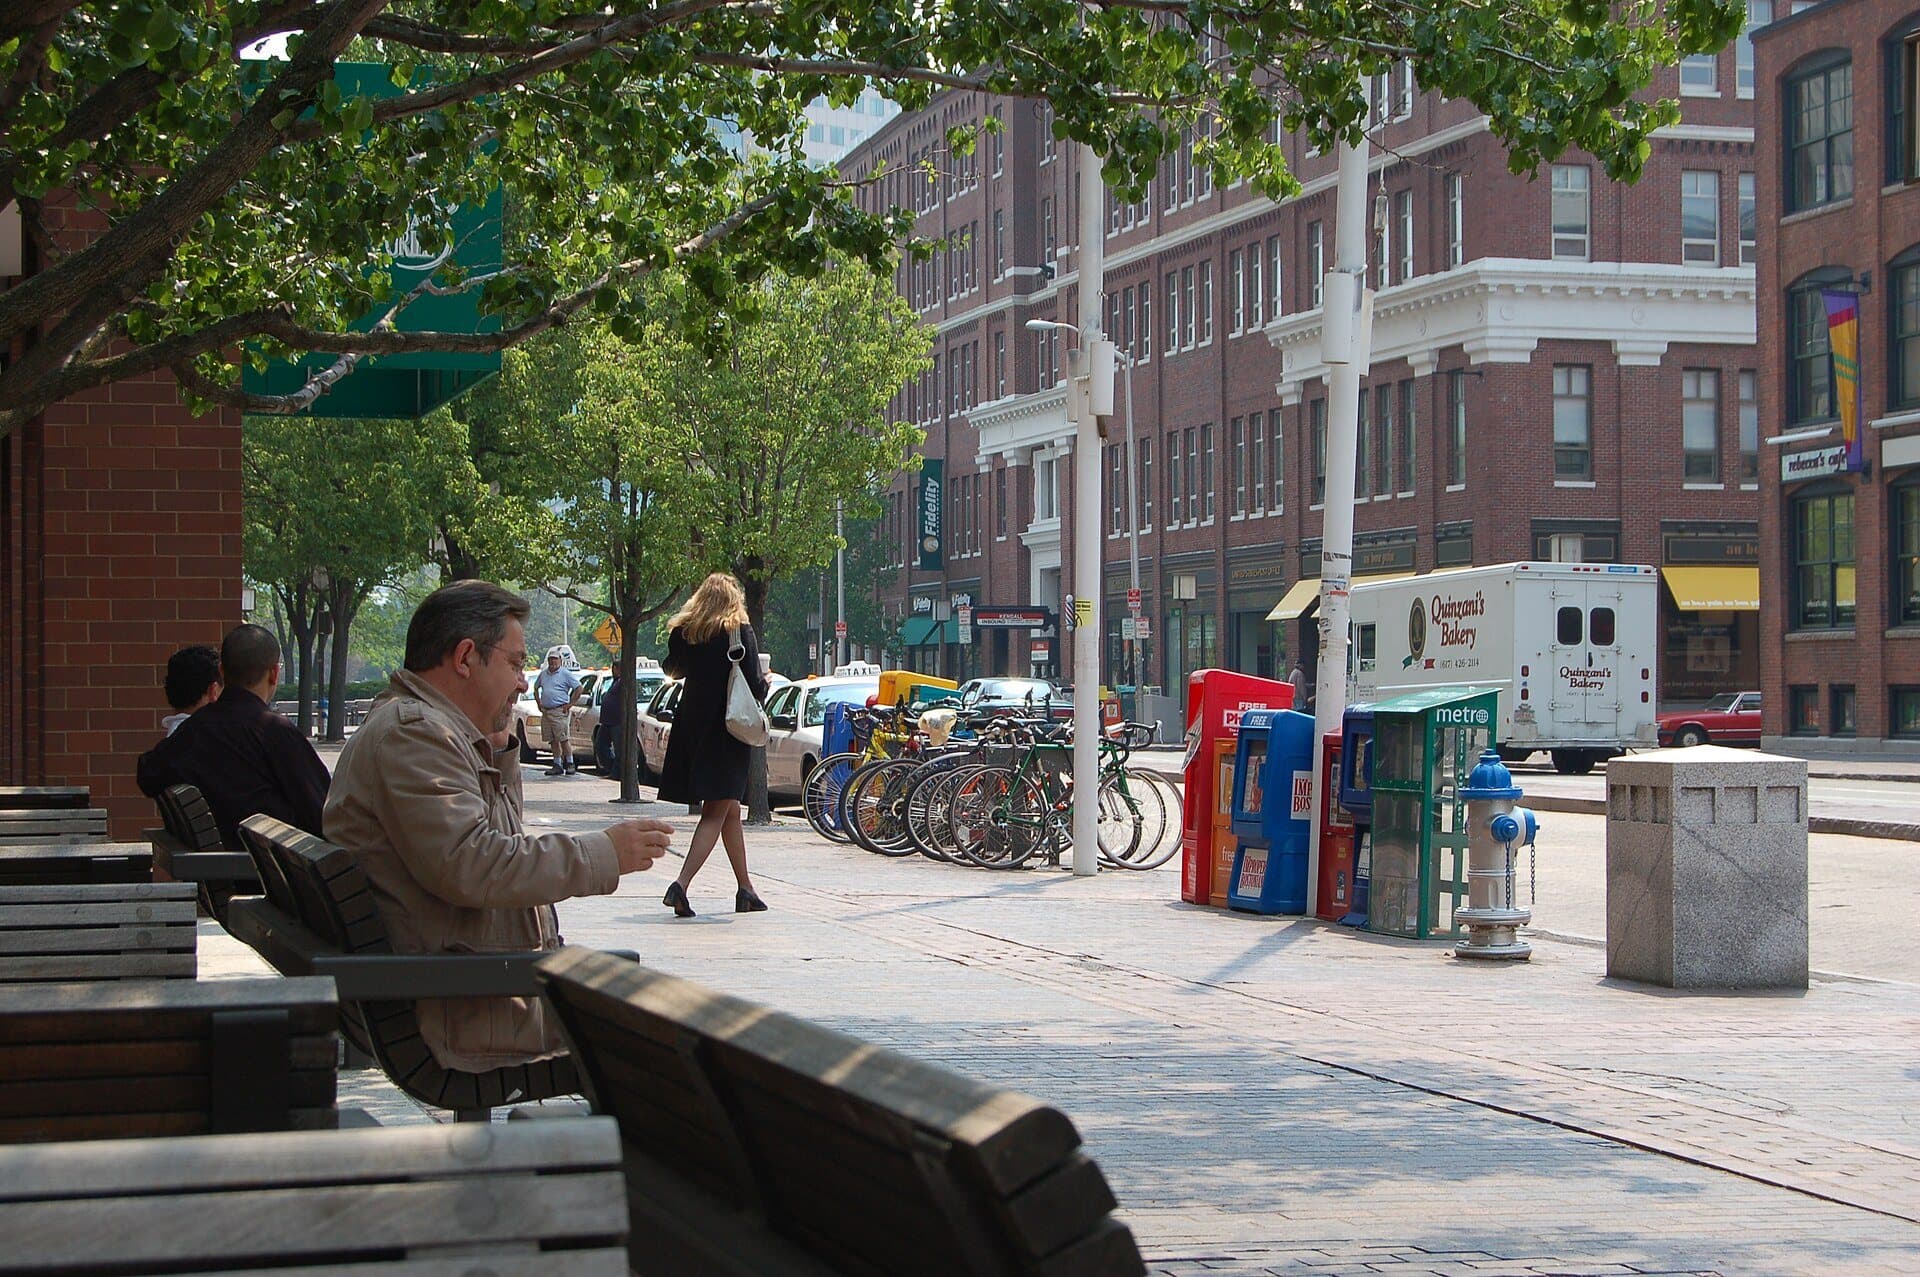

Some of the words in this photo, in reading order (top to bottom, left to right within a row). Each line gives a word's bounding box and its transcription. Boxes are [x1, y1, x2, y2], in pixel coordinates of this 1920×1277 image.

[1789, 452, 1825, 472] rebecca's
[925, 477, 939, 536] Fidelity
[1431, 590, 1485, 625] Quinzani's
[1441, 620, 1476, 650] Bakery
[847, 667, 872, 676] TAXI
[1559, 666, 1611, 679] Quinzani's
[1569, 678, 1604, 690] Bakery
[1239, 702, 1267, 711] FREE
[1250, 715, 1268, 726] FREE
[1436, 706, 1489, 724] metro
